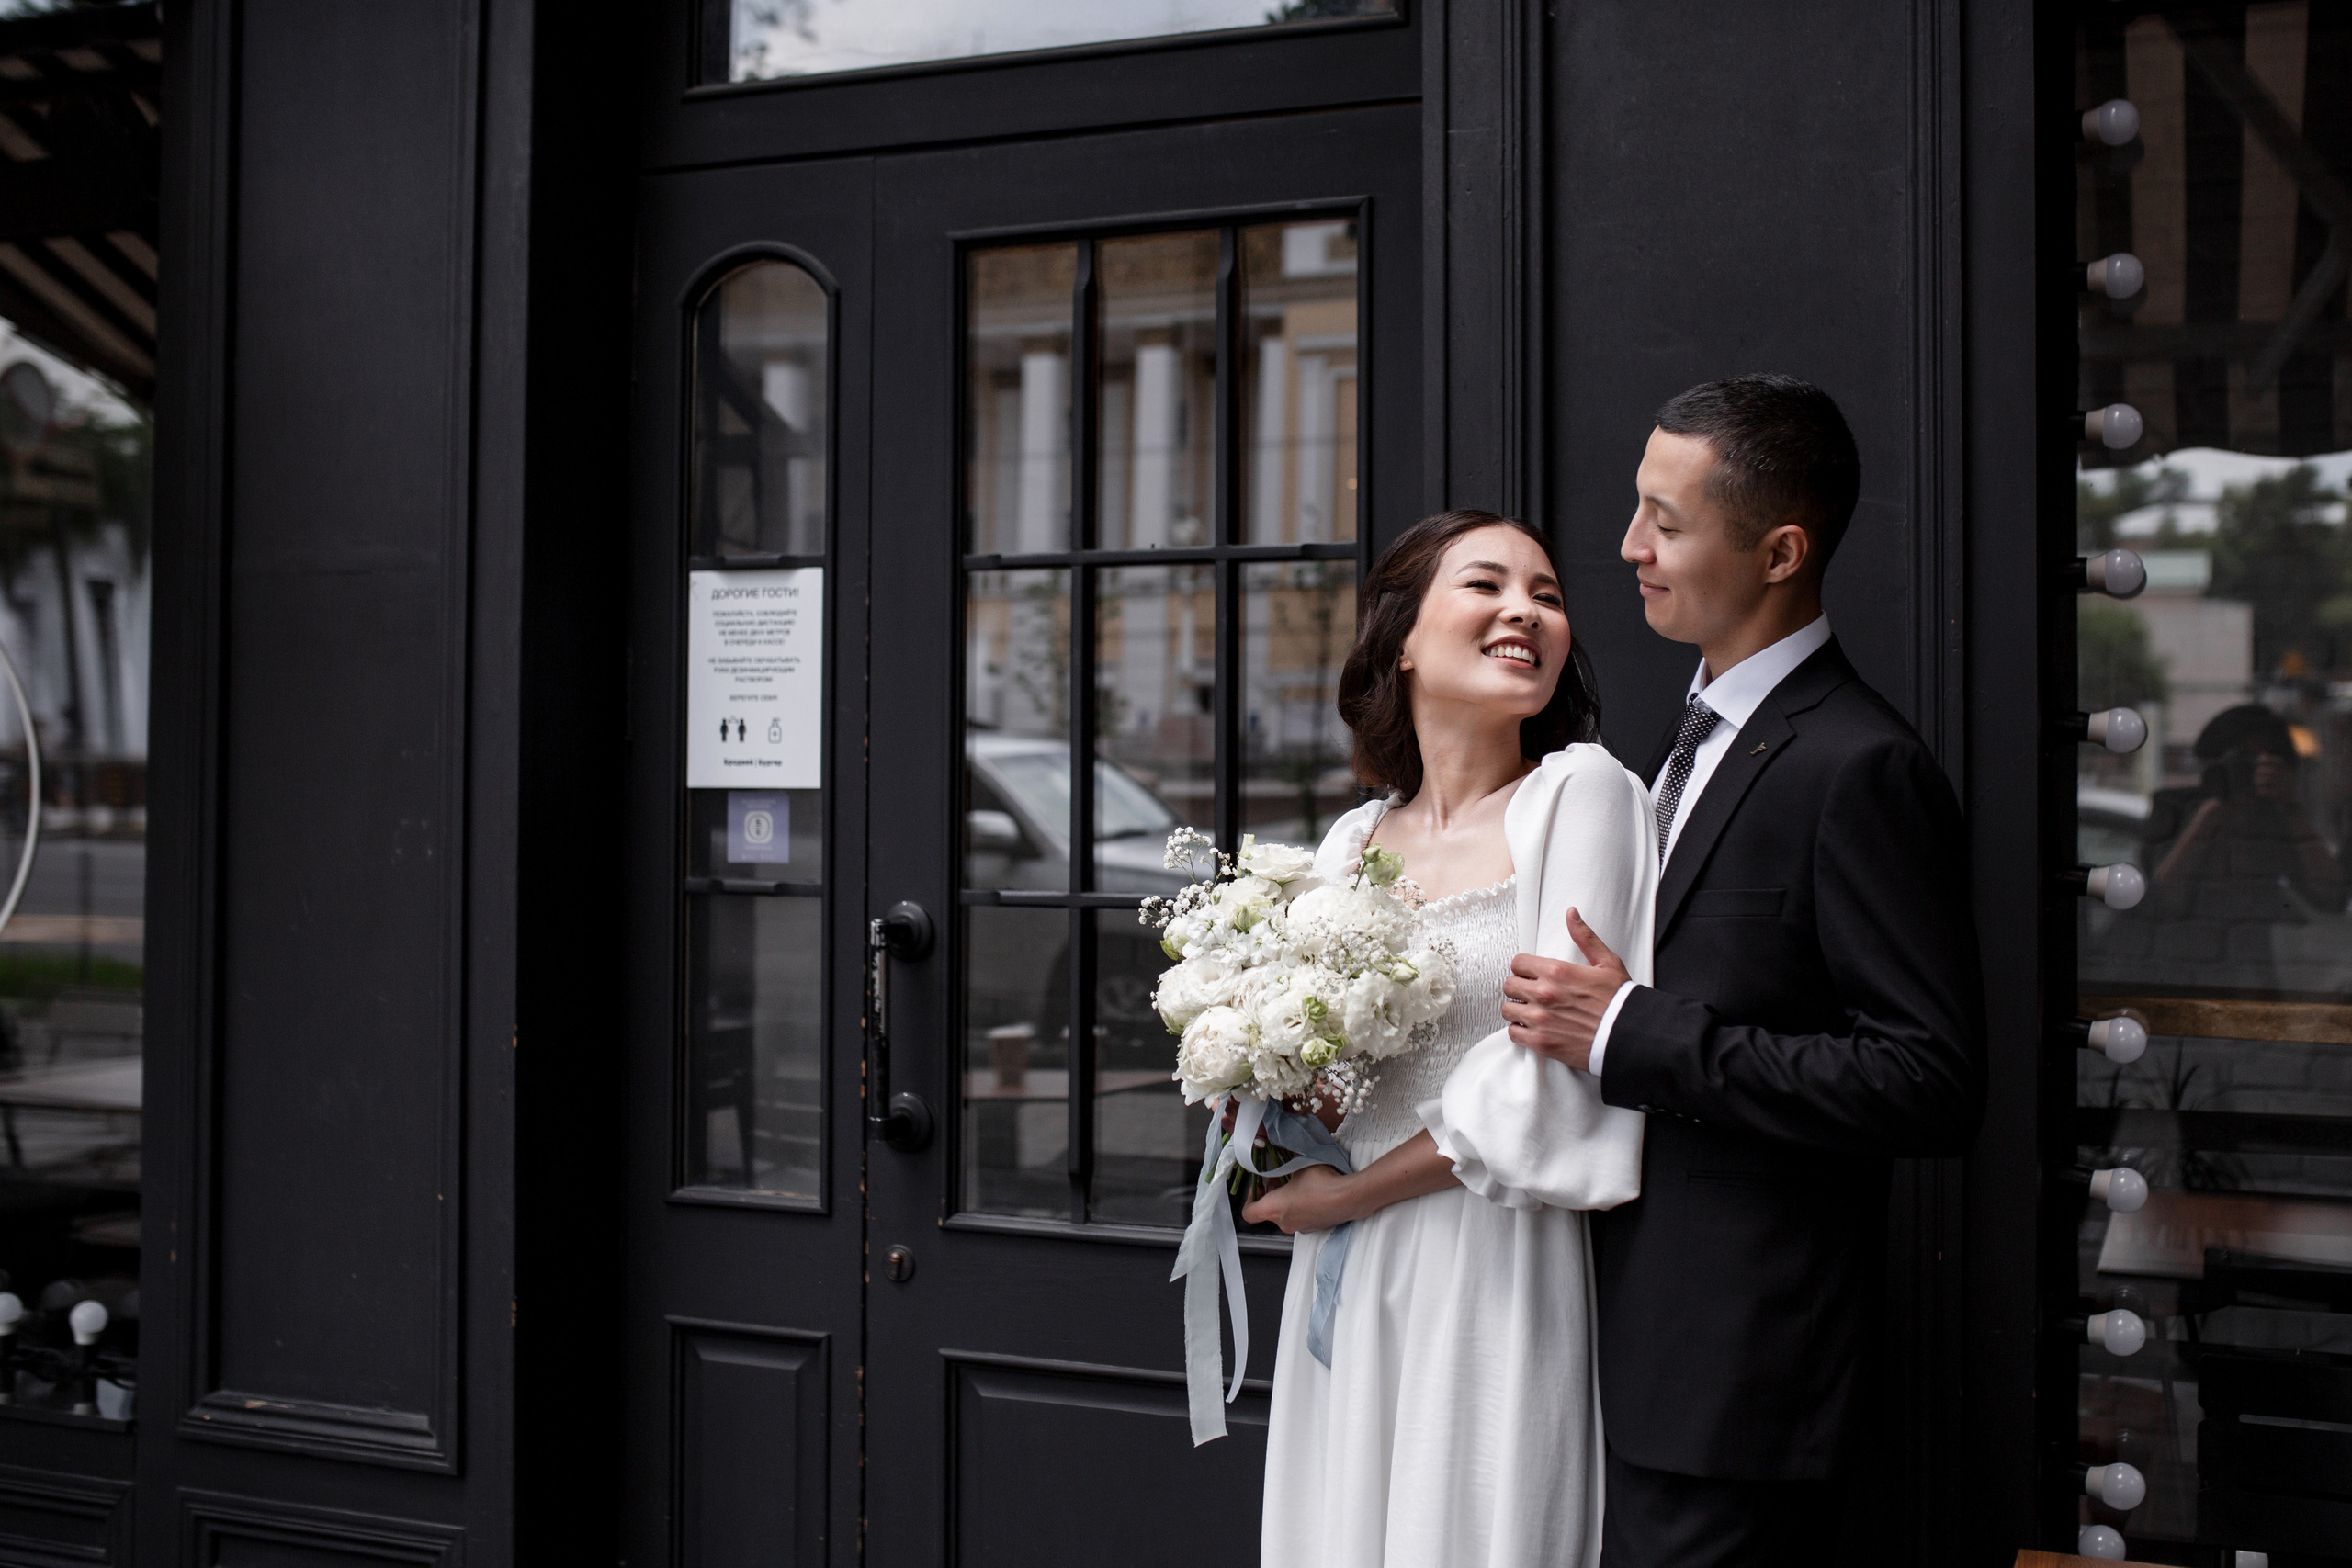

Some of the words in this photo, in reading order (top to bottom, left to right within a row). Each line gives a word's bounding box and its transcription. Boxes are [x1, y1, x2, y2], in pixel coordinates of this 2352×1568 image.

[712, 588, 760, 600] ДОРОГИЕ
[763, 587, 799, 599] ГОСТИ!
[759, 758, 782, 767] Бургер
